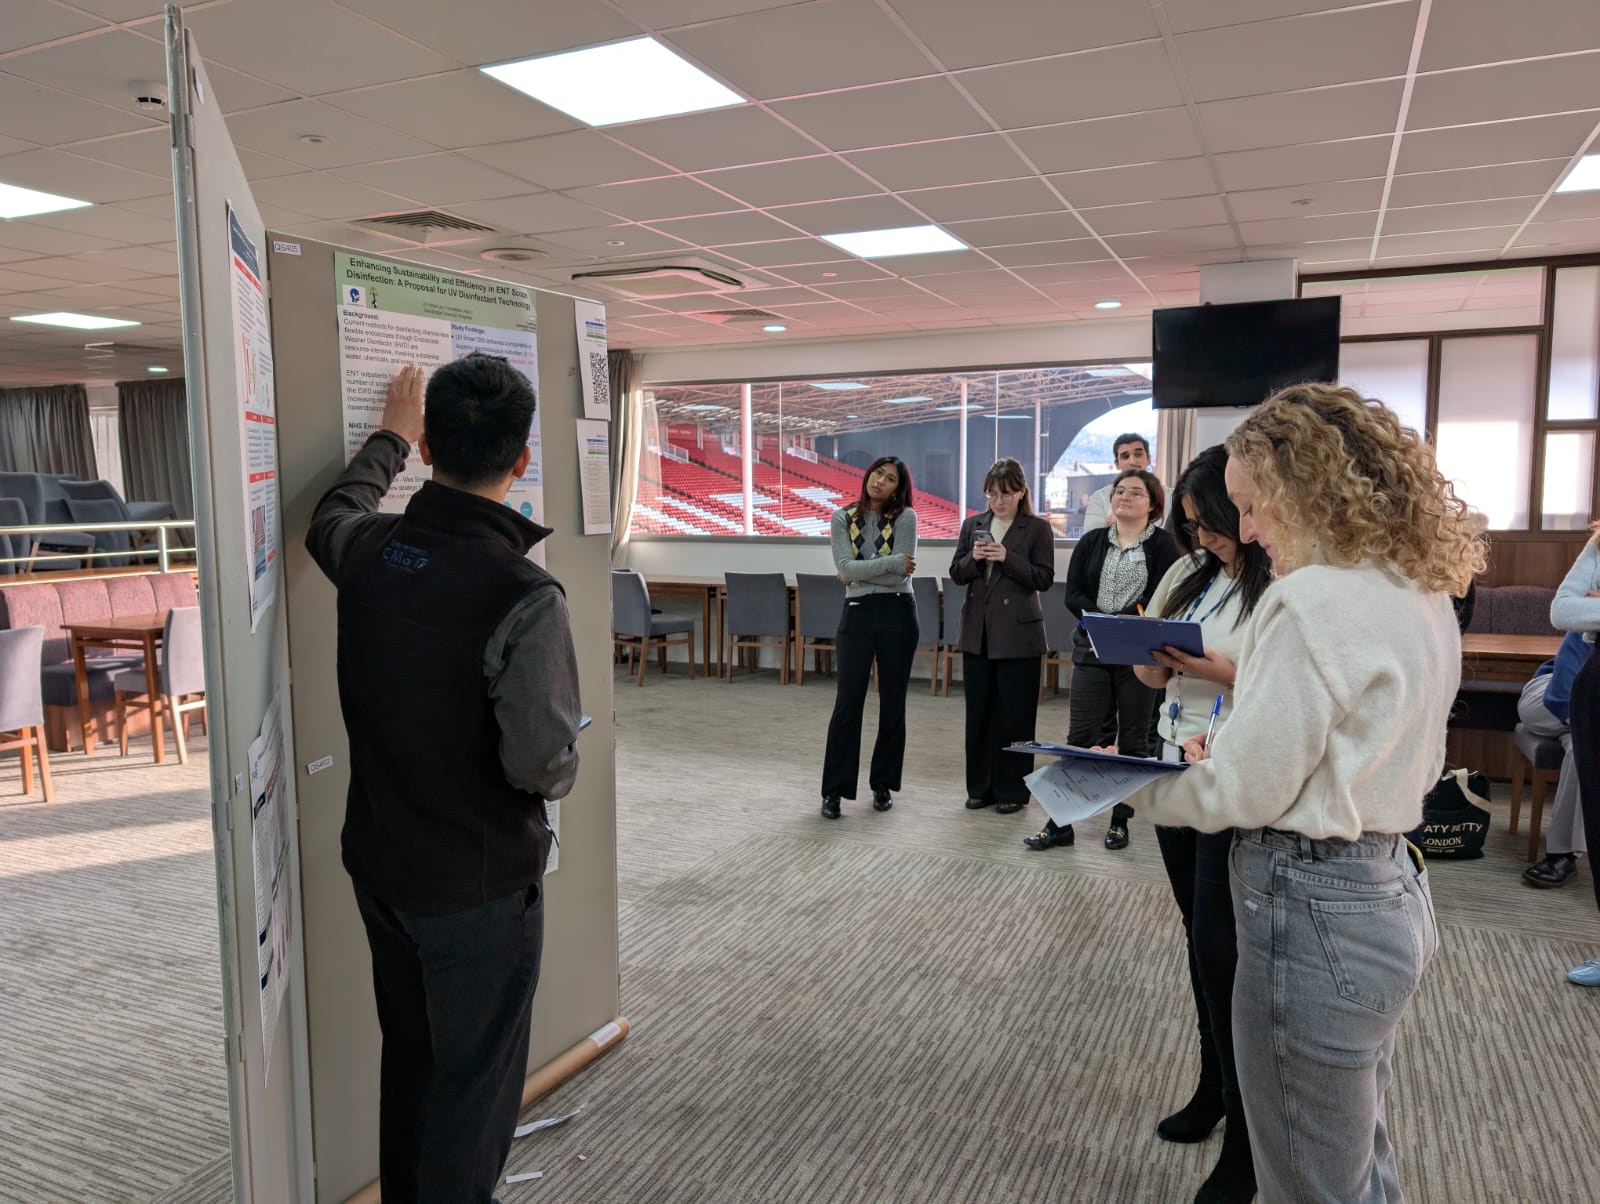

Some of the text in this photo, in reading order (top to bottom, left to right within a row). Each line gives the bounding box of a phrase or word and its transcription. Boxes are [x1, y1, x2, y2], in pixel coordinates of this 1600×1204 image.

[346, 269, 396, 286] Disinfection:
[398, 278, 403, 287] A
[405, 280, 436, 293] Proposal
[437, 286, 446, 295] for
[448, 288, 457, 297] UV
[458, 290, 497, 304] Disinfectant
[350, 258, 392, 274] Enhancing
[393, 266, 440, 284] Sustainability
[442, 276, 454, 284] and
[456, 278, 486, 292] Efficiency
[496, 286, 510, 294] ENT
[1422, 836, 1462, 847] LONDON
